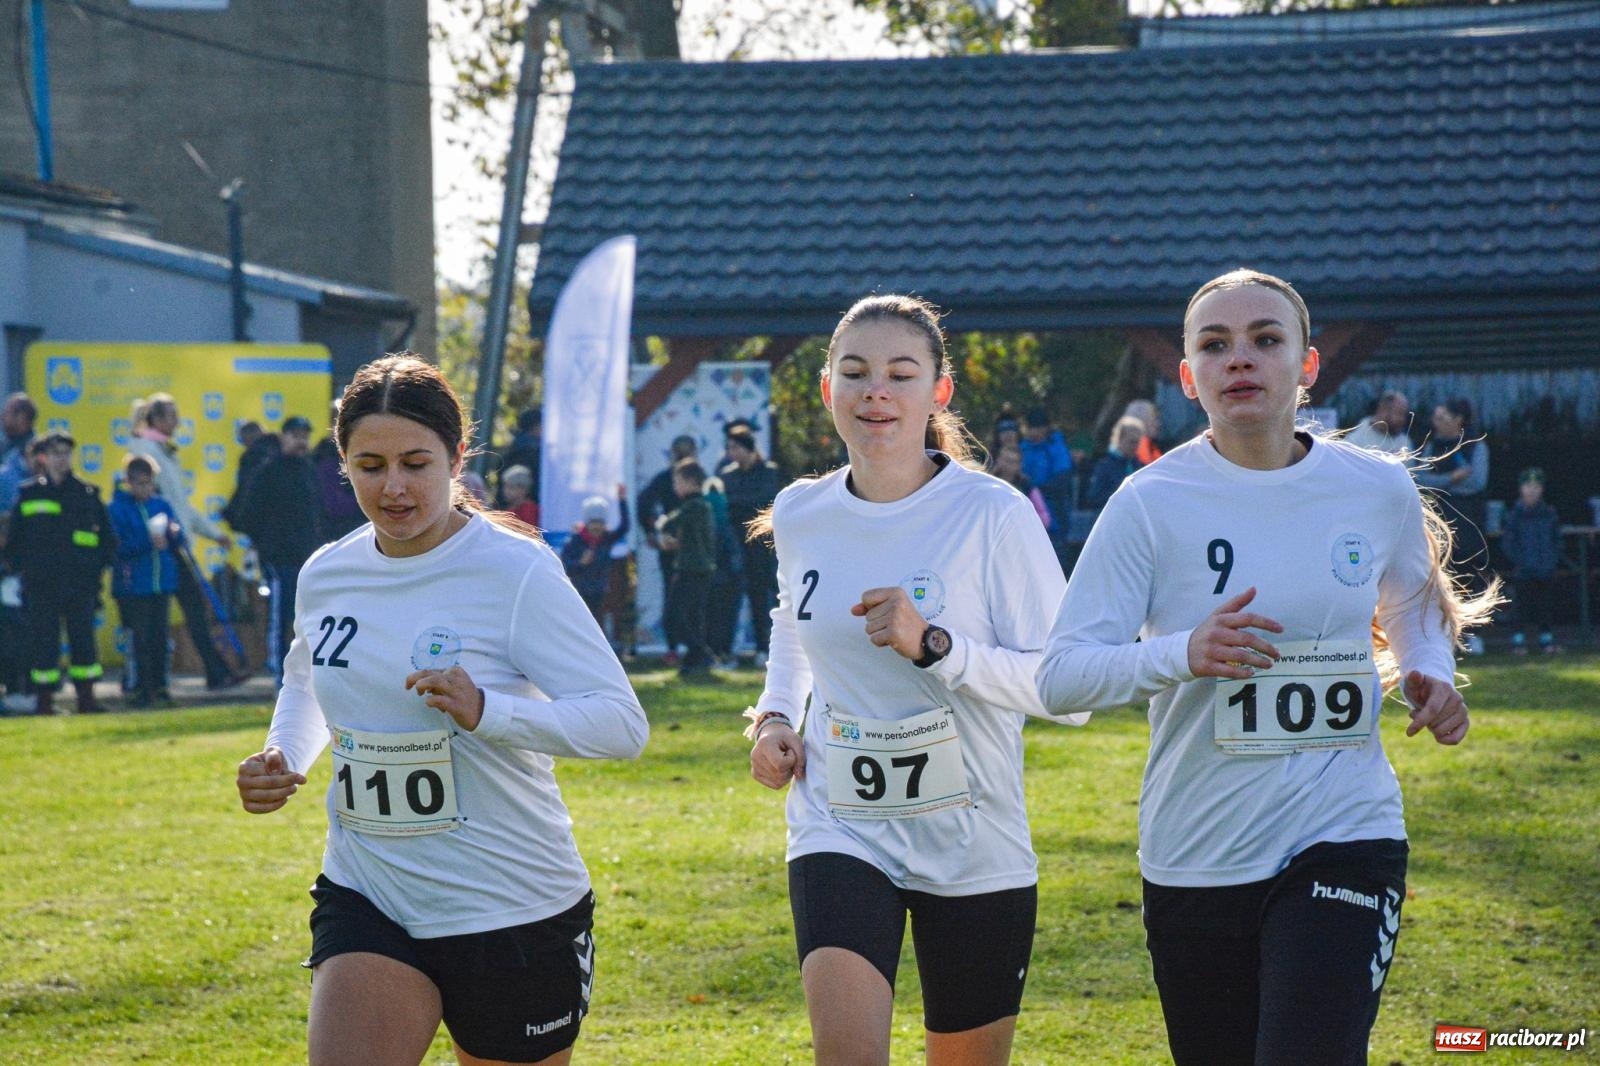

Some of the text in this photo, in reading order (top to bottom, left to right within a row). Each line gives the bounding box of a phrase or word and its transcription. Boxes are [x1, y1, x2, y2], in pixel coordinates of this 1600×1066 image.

[1207, 538, 1234, 595] 9
[797, 569, 820, 621] 2
[312, 615, 358, 669] 22
[864, 719, 949, 741] www.personalbest.pl
[1228, 680, 1364, 733] 109
[357, 741, 443, 754] www.personalbest.pl
[337, 762, 445, 817] 110
[852, 752, 930, 803] 97
[1312, 881, 1379, 910] hummel
[526, 1011, 572, 1037] hummel
